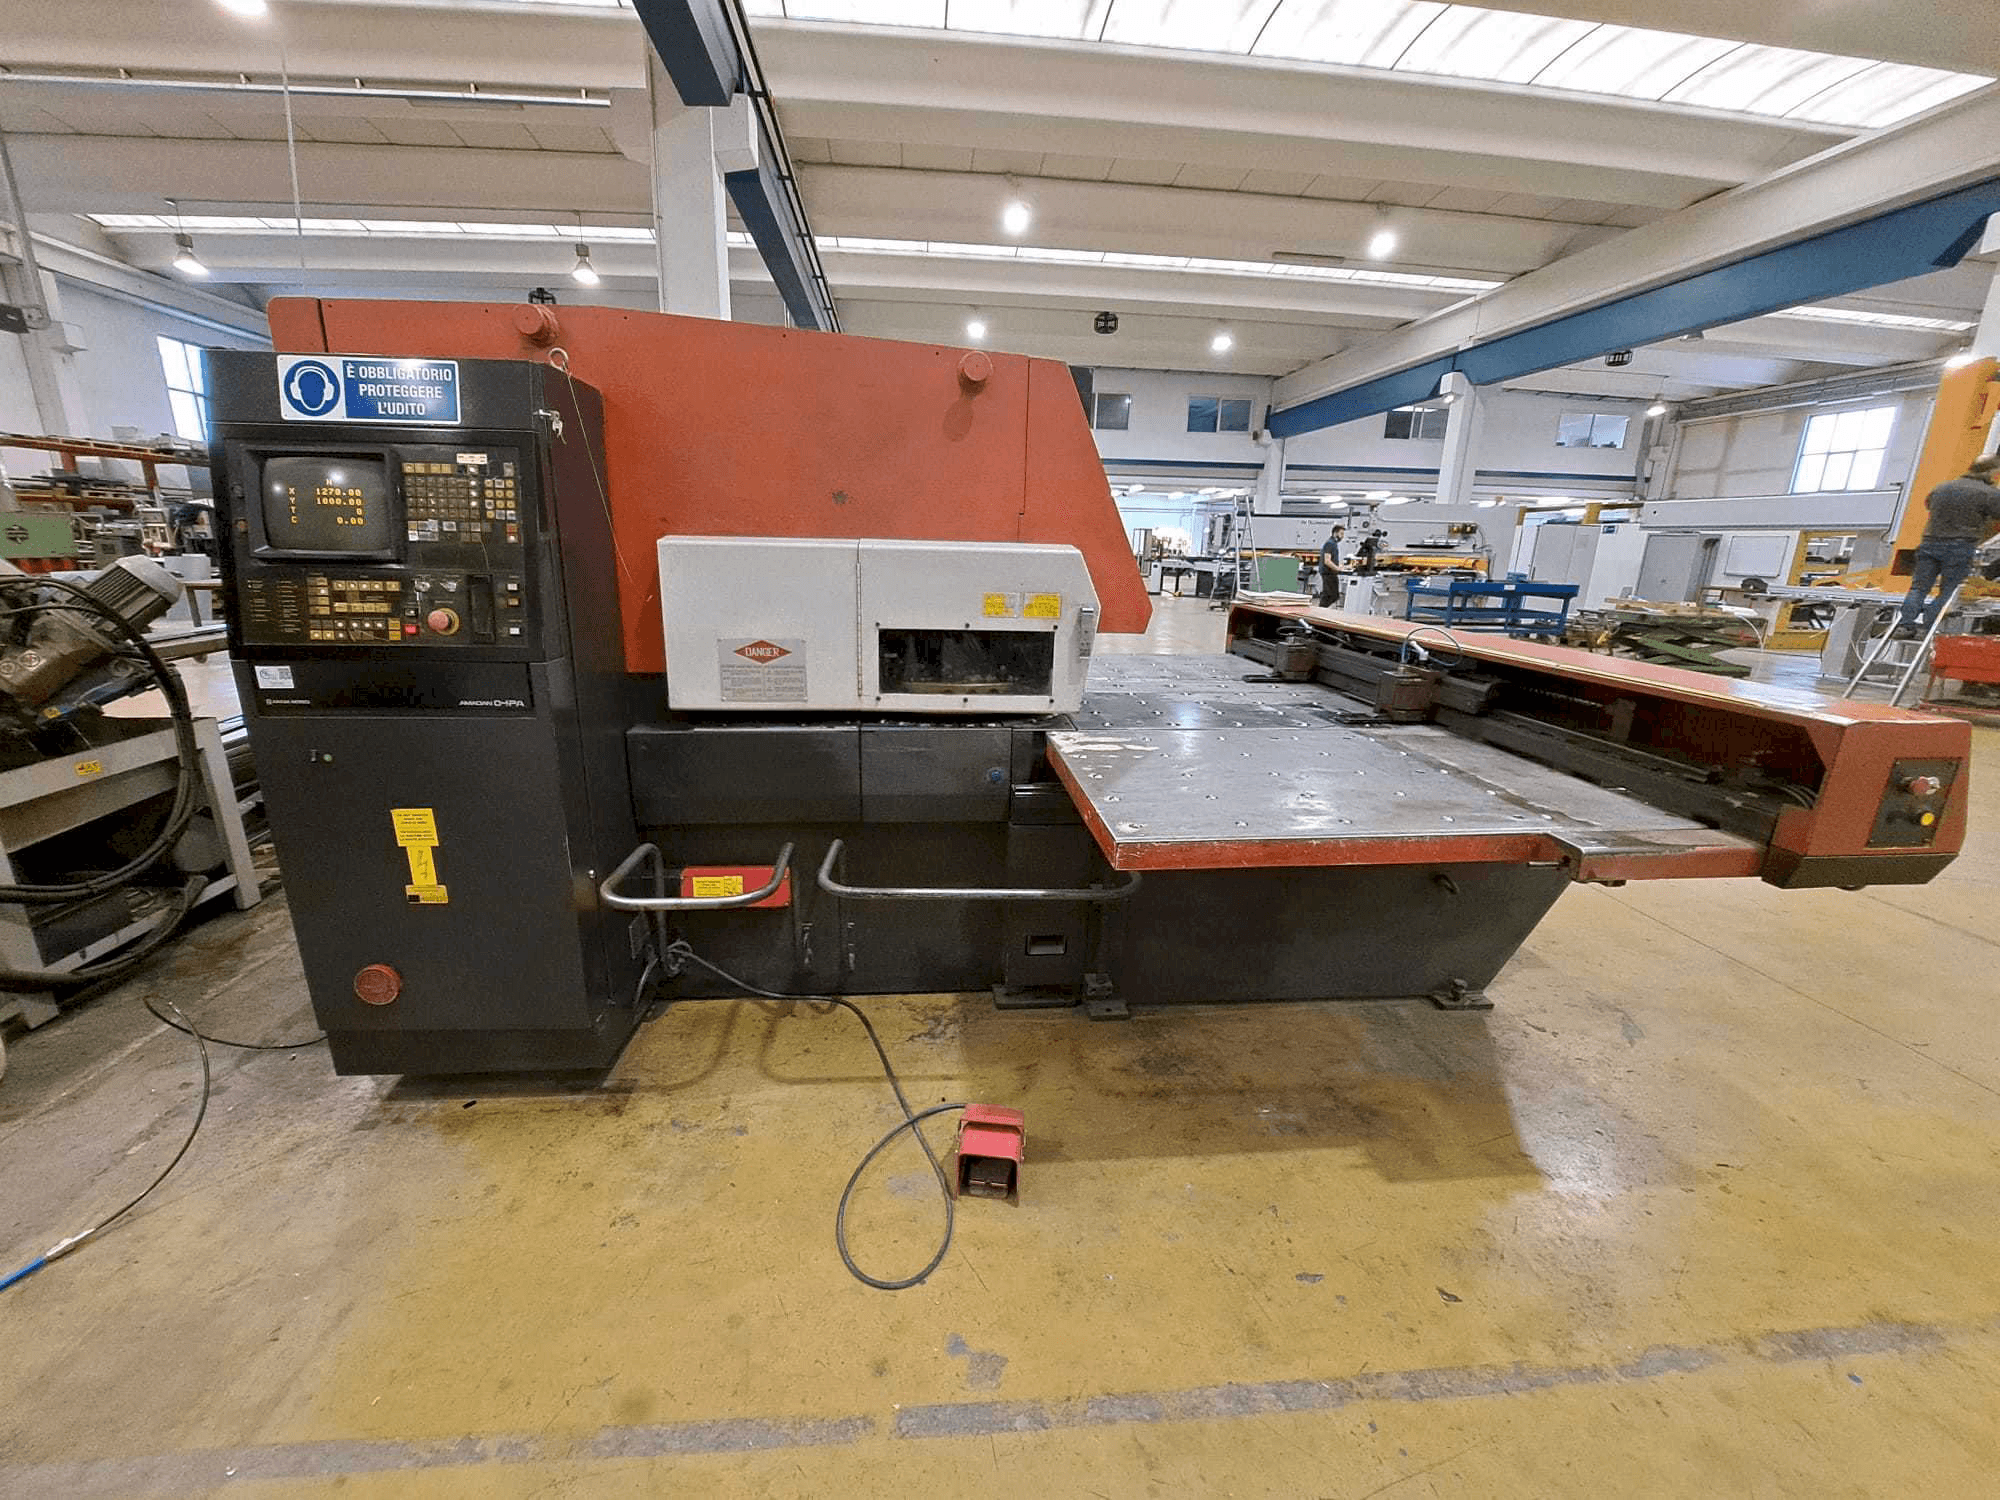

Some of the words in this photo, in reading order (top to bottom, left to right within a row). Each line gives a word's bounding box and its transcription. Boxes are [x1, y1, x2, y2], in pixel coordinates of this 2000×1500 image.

[346, 363, 355, 378] È
[359, 366, 452, 381] OBBLIGATORIO
[359, 384, 442, 398] PROTEGGERE
[377, 402, 425, 415] L'UDITO
[288, 487, 296, 495] X
[316, 487, 362, 497] 1270.00
[317, 498, 362, 506] 1000.00
[290, 506, 297, 514] T
[336, 516, 364, 525] 0.00
[745, 647, 780, 657] DANGER
